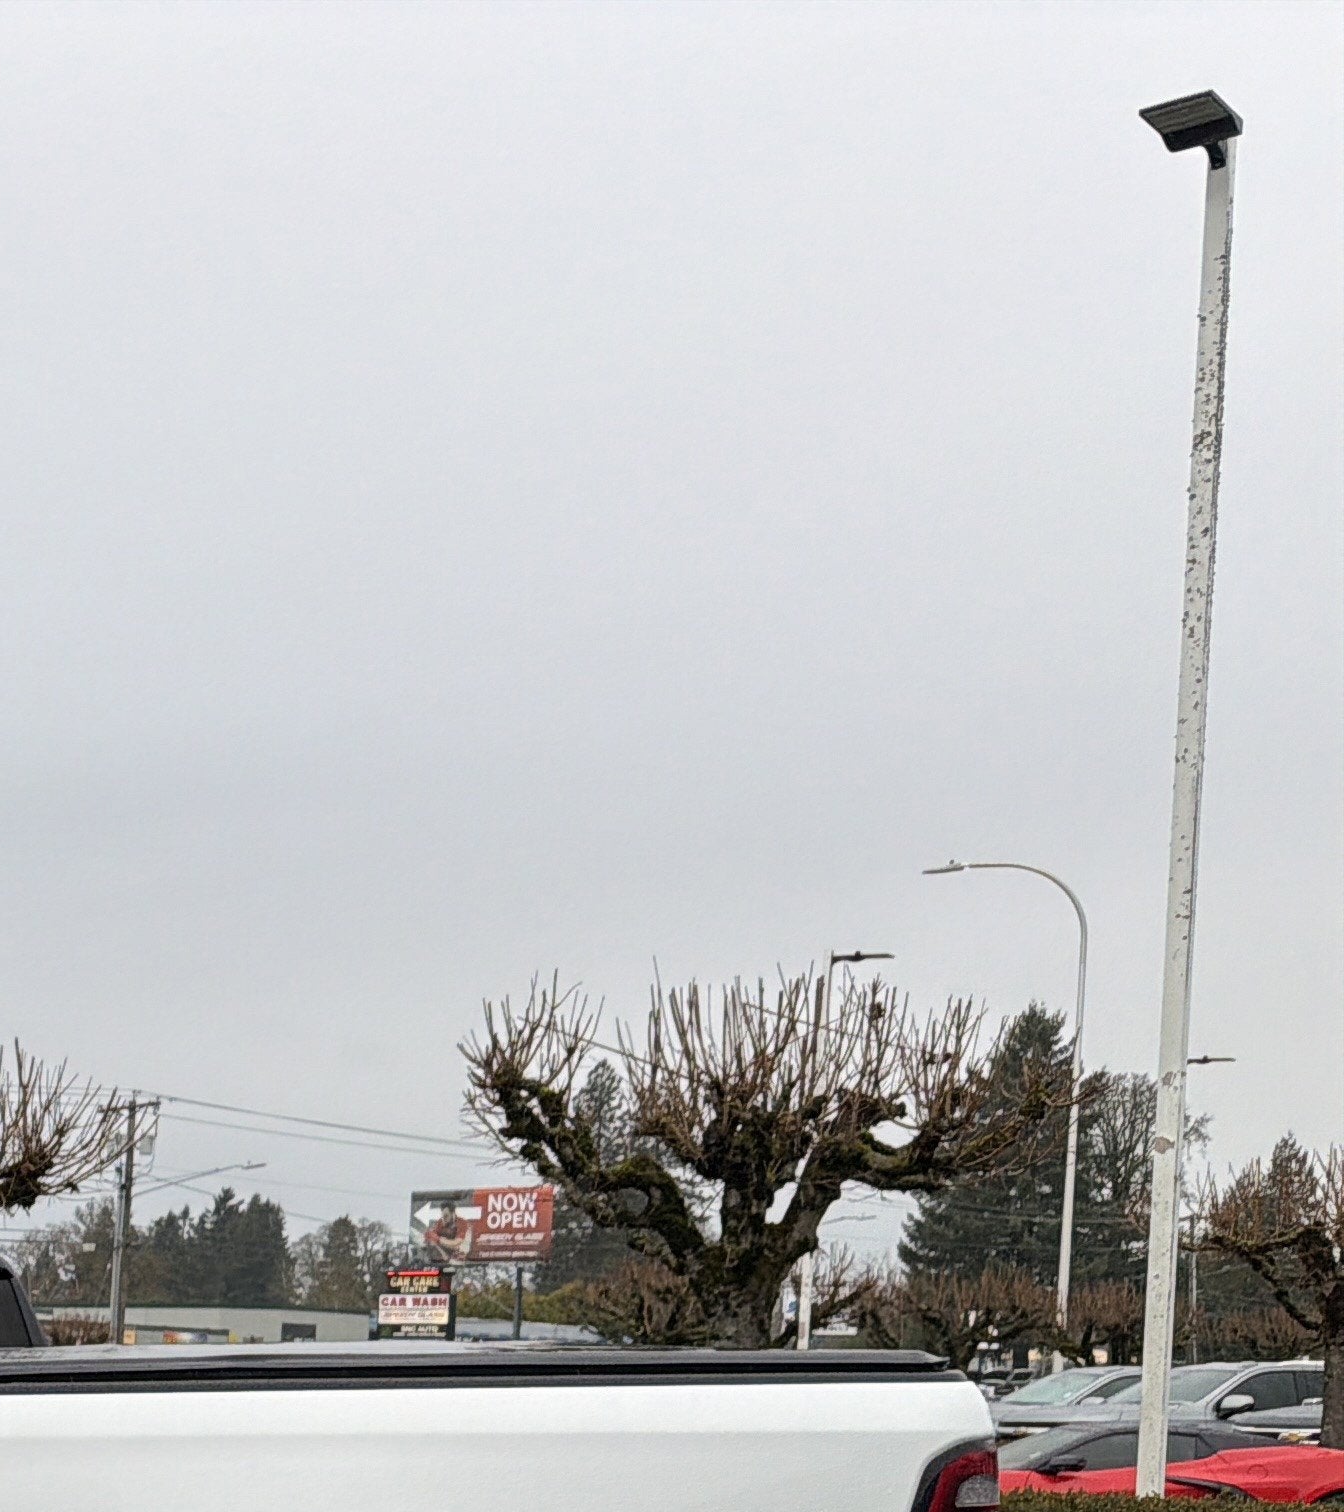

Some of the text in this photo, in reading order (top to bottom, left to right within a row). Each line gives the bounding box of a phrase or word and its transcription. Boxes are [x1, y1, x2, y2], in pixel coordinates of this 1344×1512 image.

[487, 1192, 538, 1212] NOW
[486, 1210, 538, 1230] OPEN
[381, 1296, 448, 1307] CAR WASH
